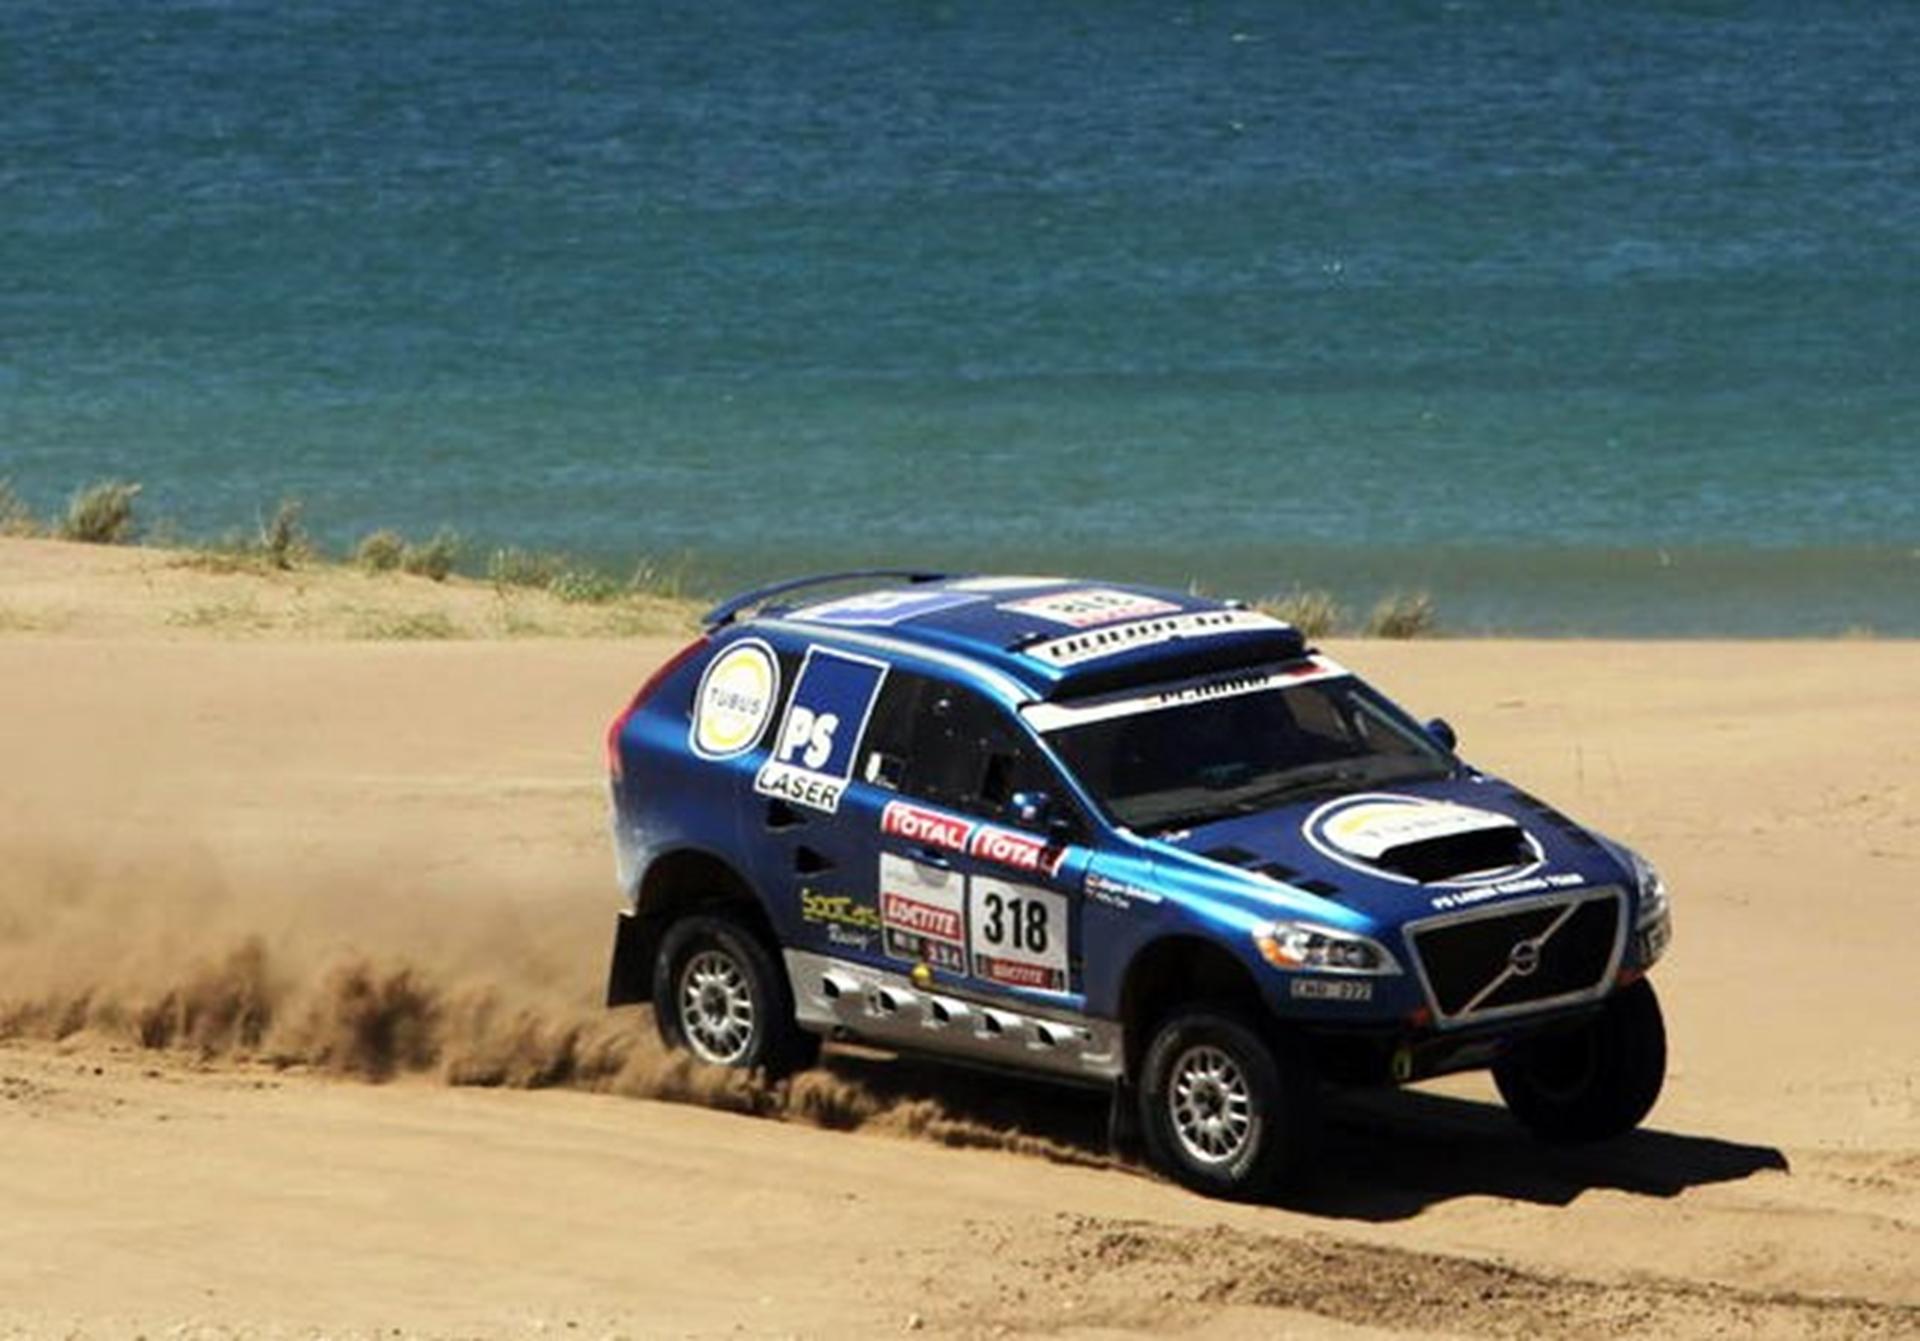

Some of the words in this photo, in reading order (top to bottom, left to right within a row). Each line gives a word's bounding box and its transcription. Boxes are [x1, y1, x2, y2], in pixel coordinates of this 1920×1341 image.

[710, 686, 762, 716] TUBUS
[778, 705, 839, 770] PS
[757, 768, 839, 809] LASER
[889, 805, 963, 850] TOTAL
[887, 896, 959, 935] LOCTITE
[983, 892, 1049, 955] 318
